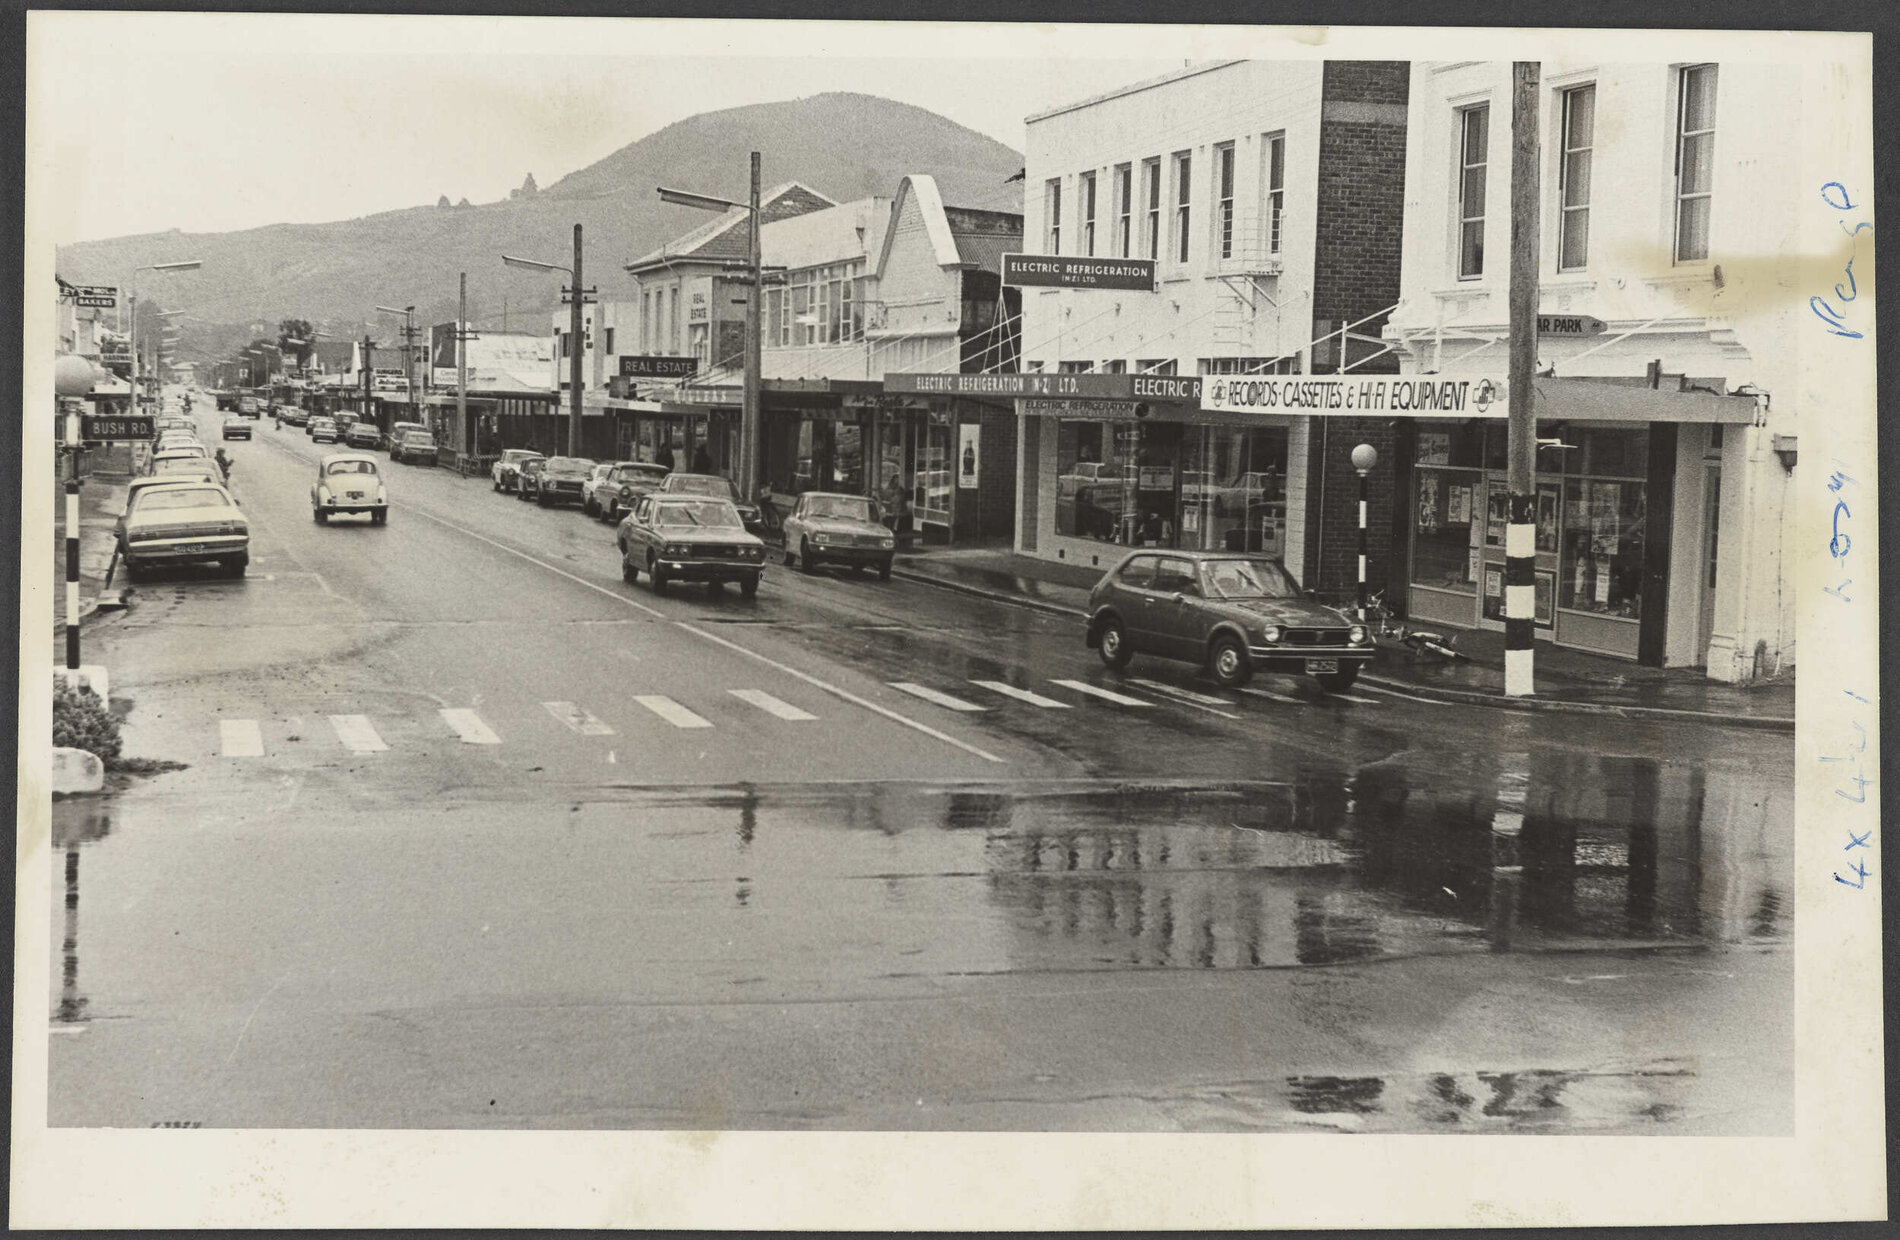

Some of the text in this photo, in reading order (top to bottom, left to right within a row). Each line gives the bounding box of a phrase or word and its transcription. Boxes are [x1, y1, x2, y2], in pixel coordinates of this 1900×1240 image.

[1011, 261, 1148, 277] ELECTRIC REFRIGERATION
[79, 298, 113, 306] BAKERS
[693, 293, 705, 304] REAL
[690, 307, 707, 320] ESTATE
[1537, 318, 1551, 332] AR
[1553, 319, 1582, 333] PARK
[625, 361, 693, 374] REAL ESTATE
[915, 376, 952, 391] ELECTRIC
[958, 377, 1024, 392] REFRIGERATION
[1058, 377, 1079, 393] LTD.
[1134, 378, 1188, 397] ELECTRIC
[1391, 381, 1469, 411] EQUIPMENT
[1025, 400, 1136, 412] ELECTRIC REFRIGERATION
[93, 422, 125, 434] BUSH
